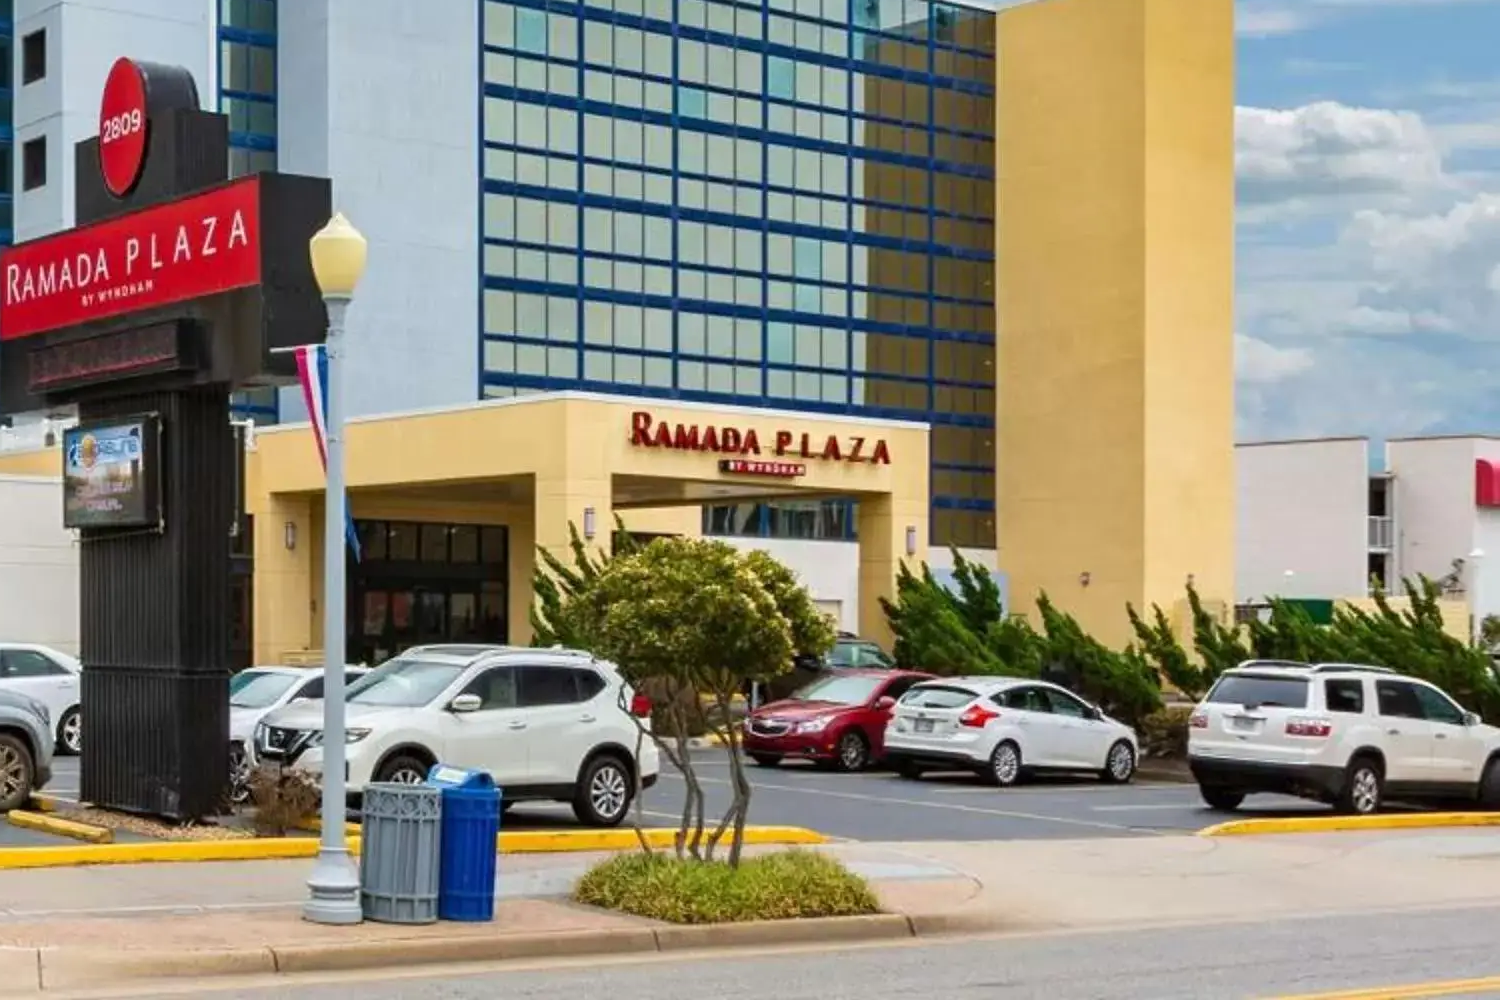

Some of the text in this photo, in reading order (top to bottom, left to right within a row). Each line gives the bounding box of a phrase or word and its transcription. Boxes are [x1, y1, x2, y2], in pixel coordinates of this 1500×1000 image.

[103, 108, 141, 143] 2809
[6, 209, 247, 306] RAMADA PLAZA
[81, 279, 153, 307] BY WYNDHAM
[631, 411, 891, 464] RAMADA PLAZA
